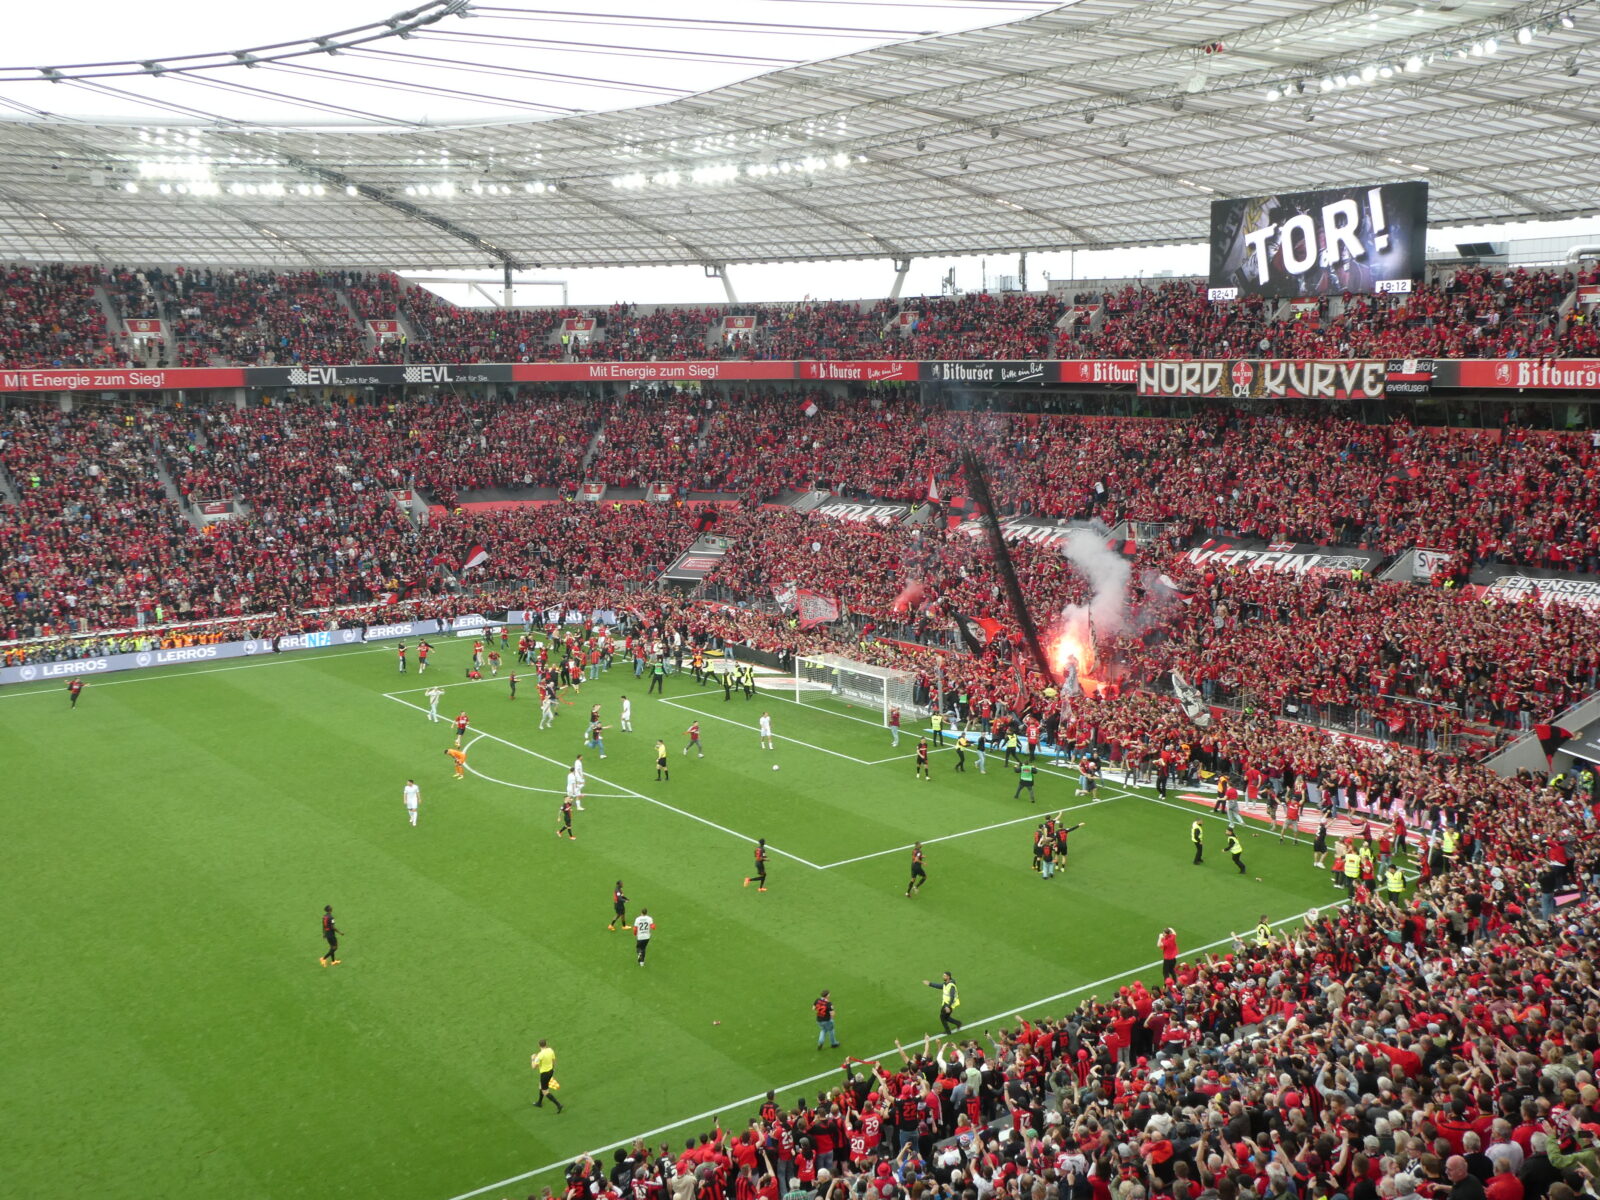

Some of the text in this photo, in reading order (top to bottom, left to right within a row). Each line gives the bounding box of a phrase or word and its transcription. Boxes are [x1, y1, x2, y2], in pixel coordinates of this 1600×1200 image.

[1245, 187, 1389, 286] TOR!
[1211, 289, 1235, 299] 82:41
[420, 366, 453, 382] EVL
[590, 365, 719, 379] Mit Energie zum Sieg!
[942, 363, 994, 380] Bitburger
[1030, 363, 1044, 374] Bit
[1093, 362, 1138, 381] Bitbur
[1517, 361, 1600, 387] Bitburg
[4, 372, 165, 389] Mit Energie zum Sieg!
[1139, 362, 1385, 398] NORD KURVE
[1386, 383, 1429, 391] everkusen
[1232, 383, 1250, 397] 04
[157, 647, 216, 662] LERROS
[43, 659, 107, 676] LERROS
[639, 922, 649, 931] 22
[762, 1108, 775, 1121] 40
[866, 1119, 879, 1136] 29
[851, 1138, 864, 1151] 20
